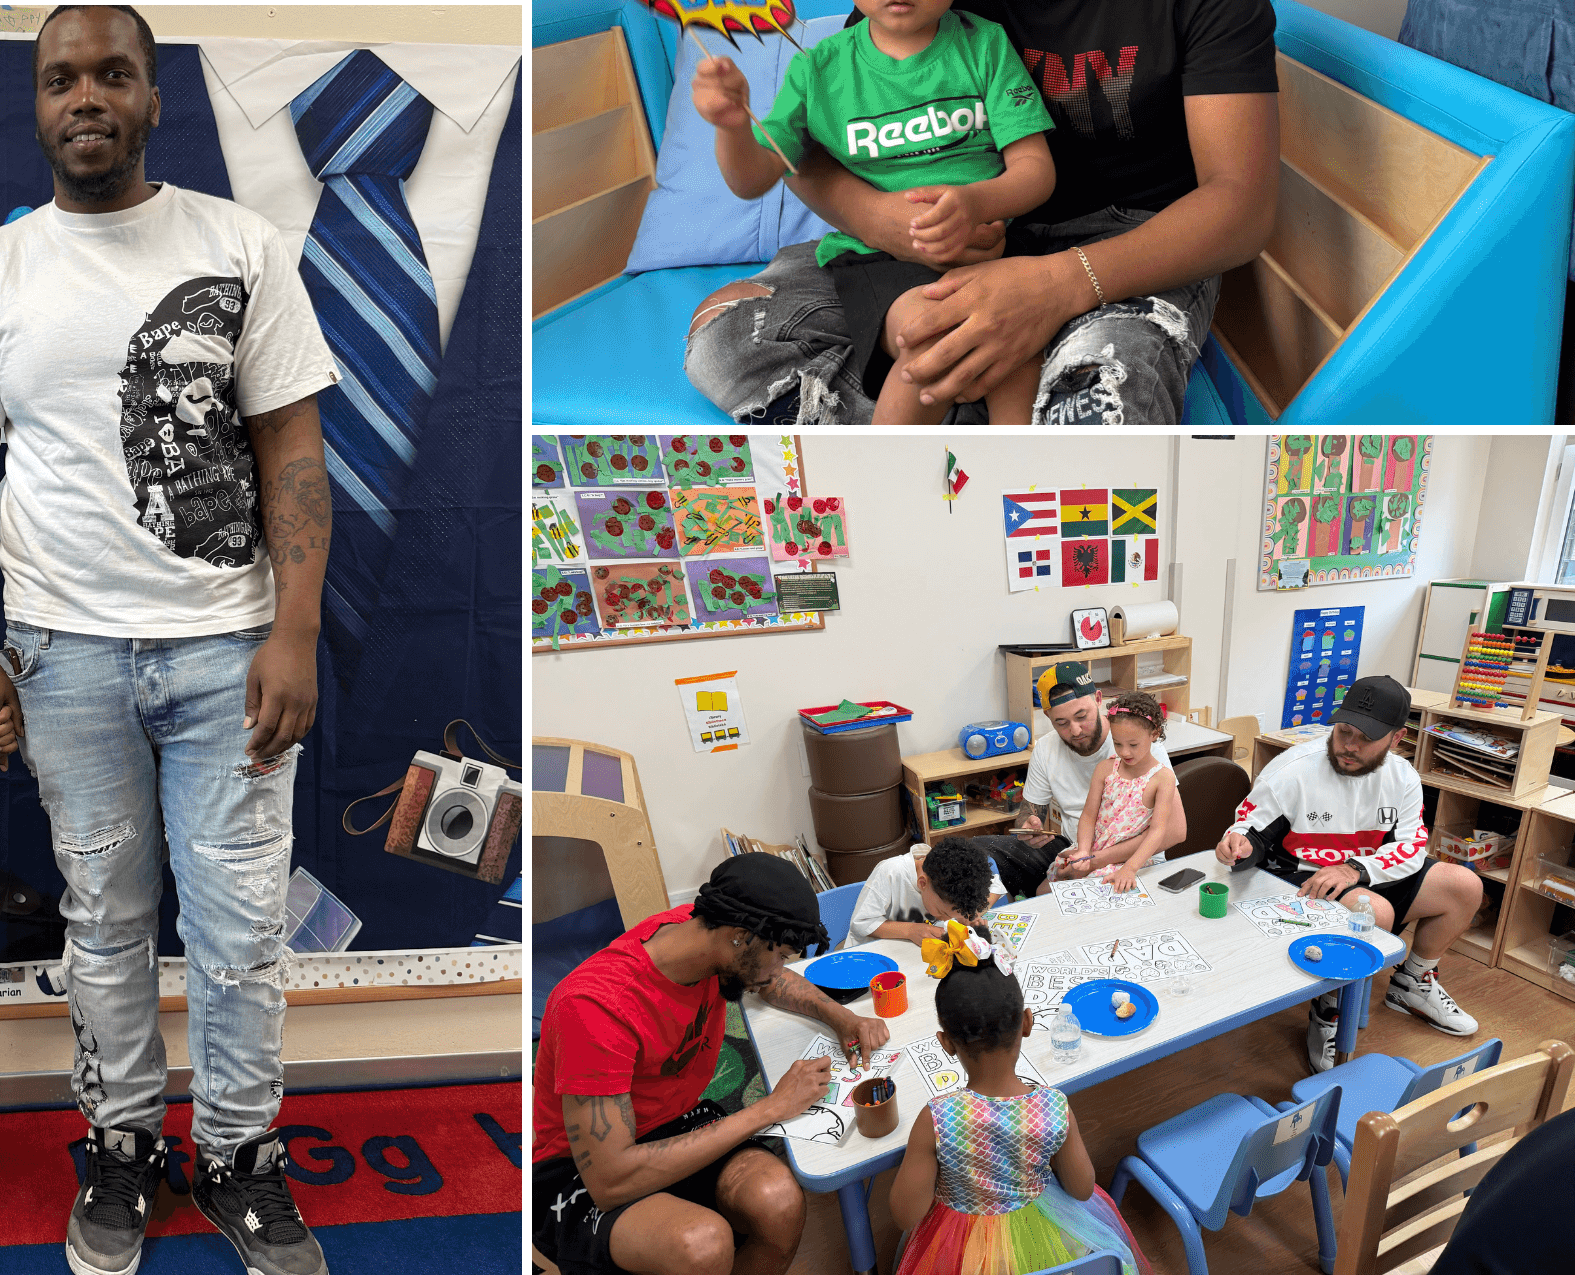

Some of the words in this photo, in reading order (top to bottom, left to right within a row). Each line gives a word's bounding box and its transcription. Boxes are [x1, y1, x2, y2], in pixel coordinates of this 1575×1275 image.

[137, 320, 182, 350] Bape
[174, 466, 221, 495] BATHING
[1076, 672, 1093, 686] OAK
[1031, 965, 1109, 976] WORLD'S
[278, 1124, 445, 1197] Gg
